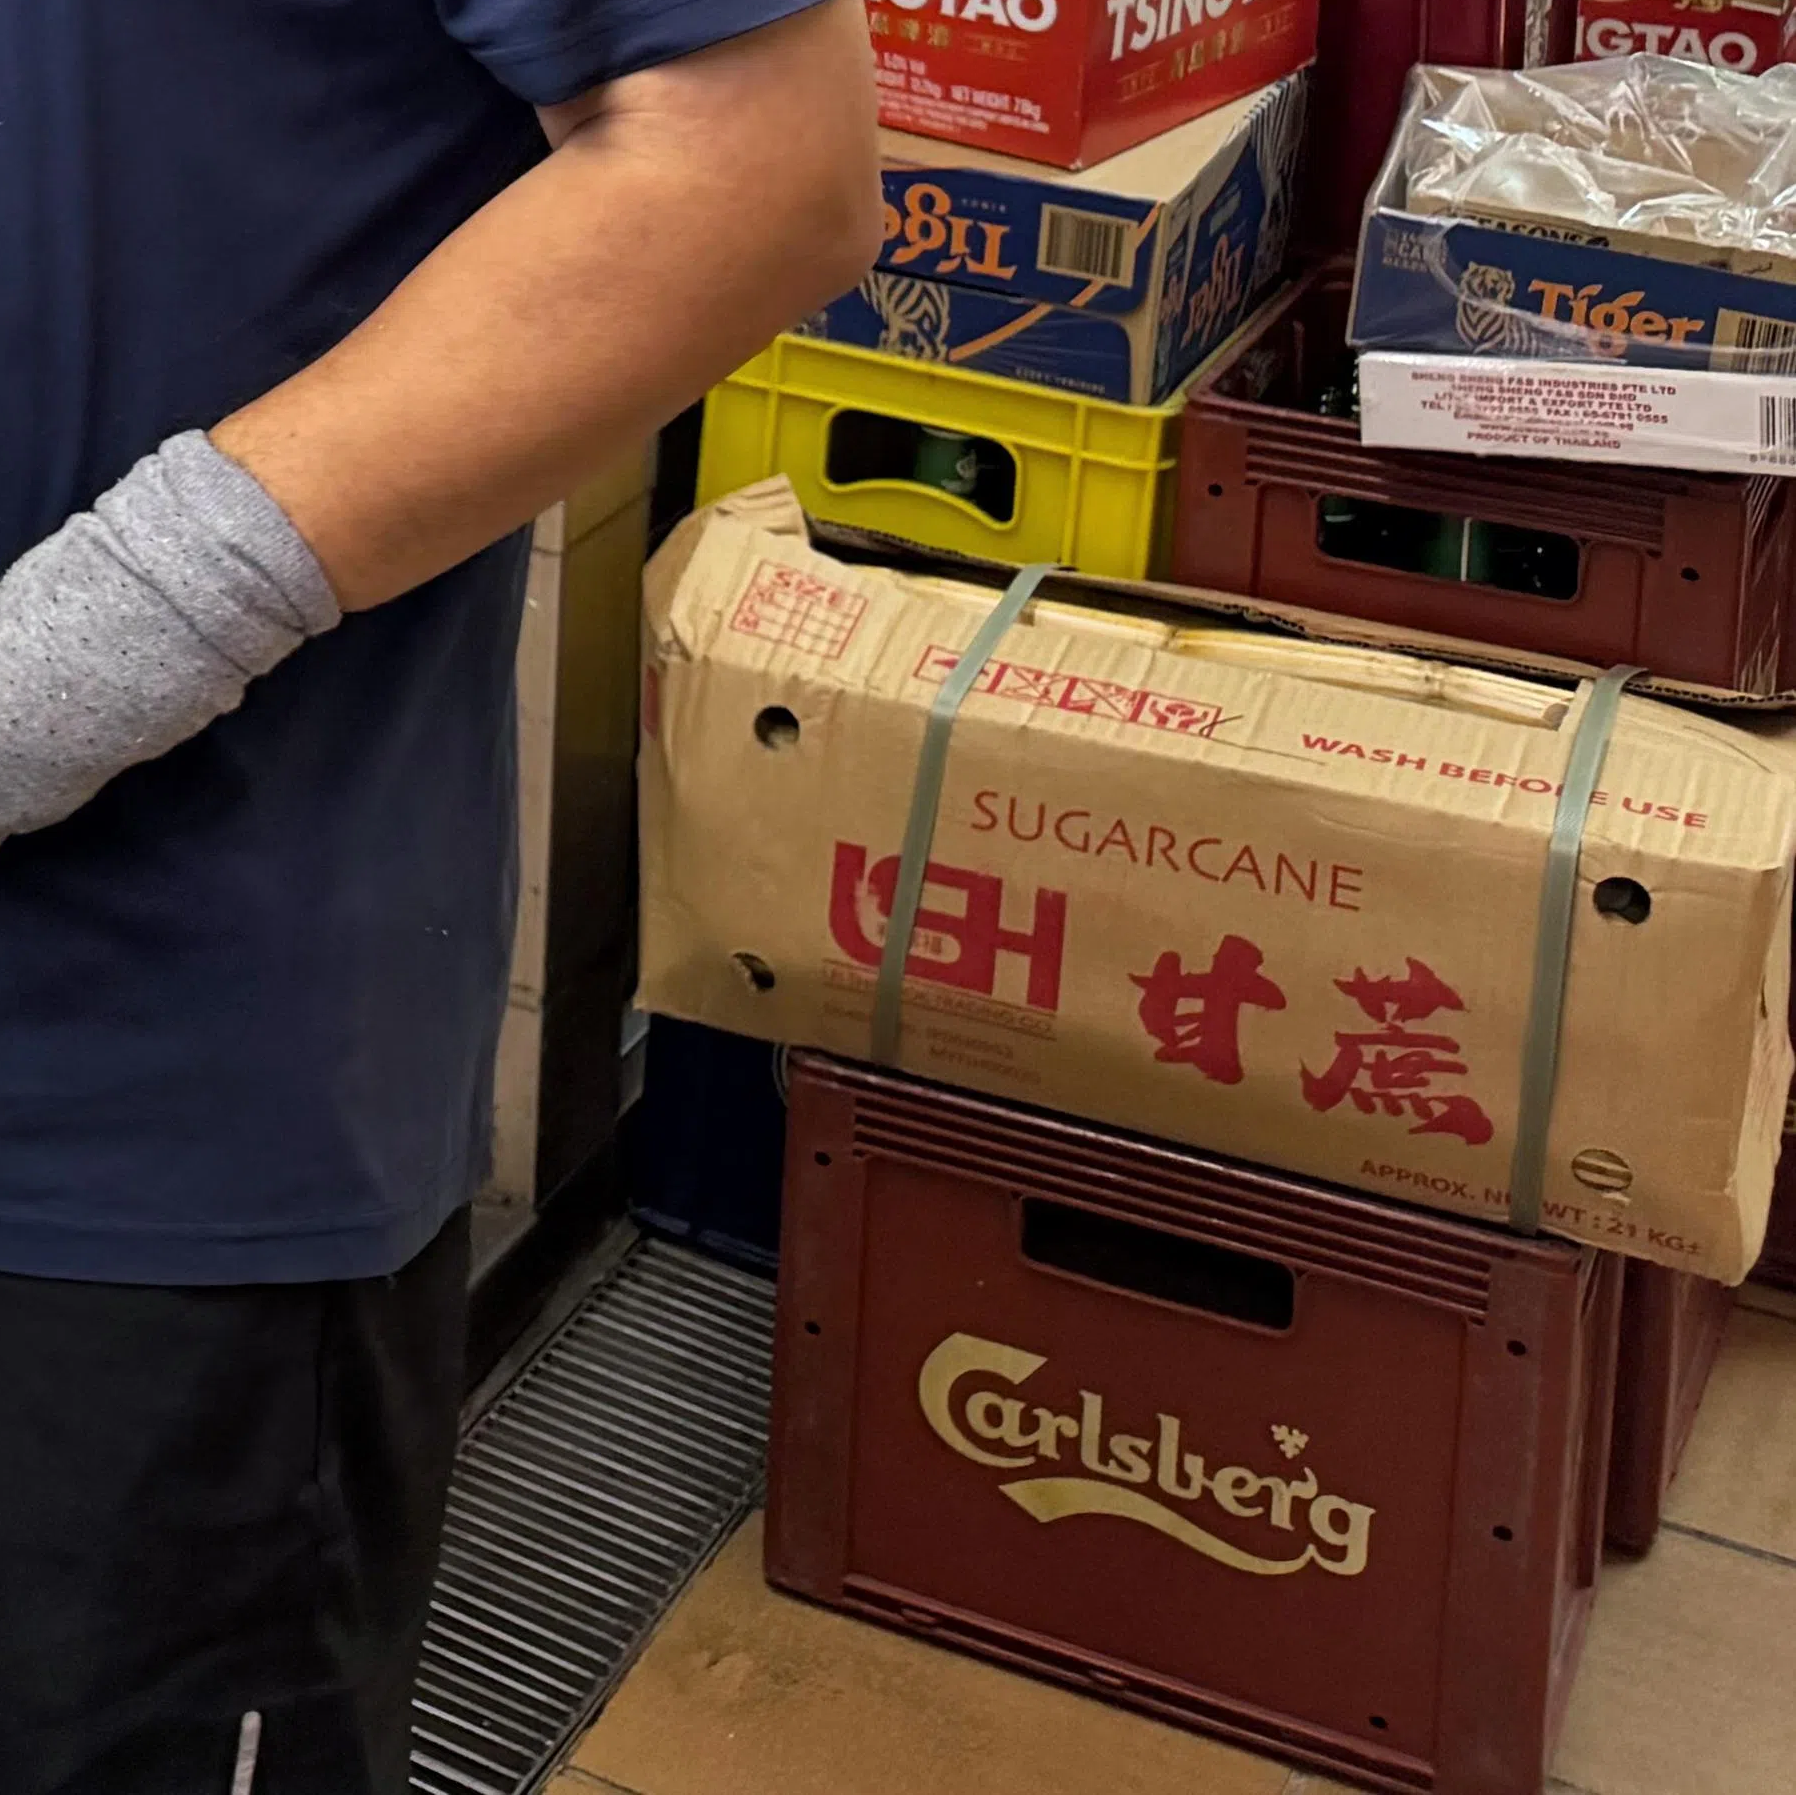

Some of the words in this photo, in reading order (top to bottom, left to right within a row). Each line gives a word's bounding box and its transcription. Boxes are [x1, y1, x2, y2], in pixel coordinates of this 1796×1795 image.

[1529, 279, 1705, 357] Tiger
[1538, 378, 1618, 392] INDUSTRIES
[1622, 382, 1649, 393] PTE
[1653, 384, 1677, 395] LTD
[1541, 397, 1595, 409] EXPORT
[1599, 400, 1626, 411] PTE
[1629, 402, 1653, 413] LTD
[1466, 430, 1525, 445] PRODUCT
[1528, 434, 1549, 445] OF
[1553, 436, 1622, 450] THAILAND
[1302, 734, 1427, 771] WASH
[1622, 797, 1711, 829] USE
[969, 790, 1365, 911] SUGARCANE
[1127, 935, 1495, 1146] 甘蔗
[1360, 1159, 1475, 1200] APPROX.
[919, 1331, 1375, 1575] Carlsberg
